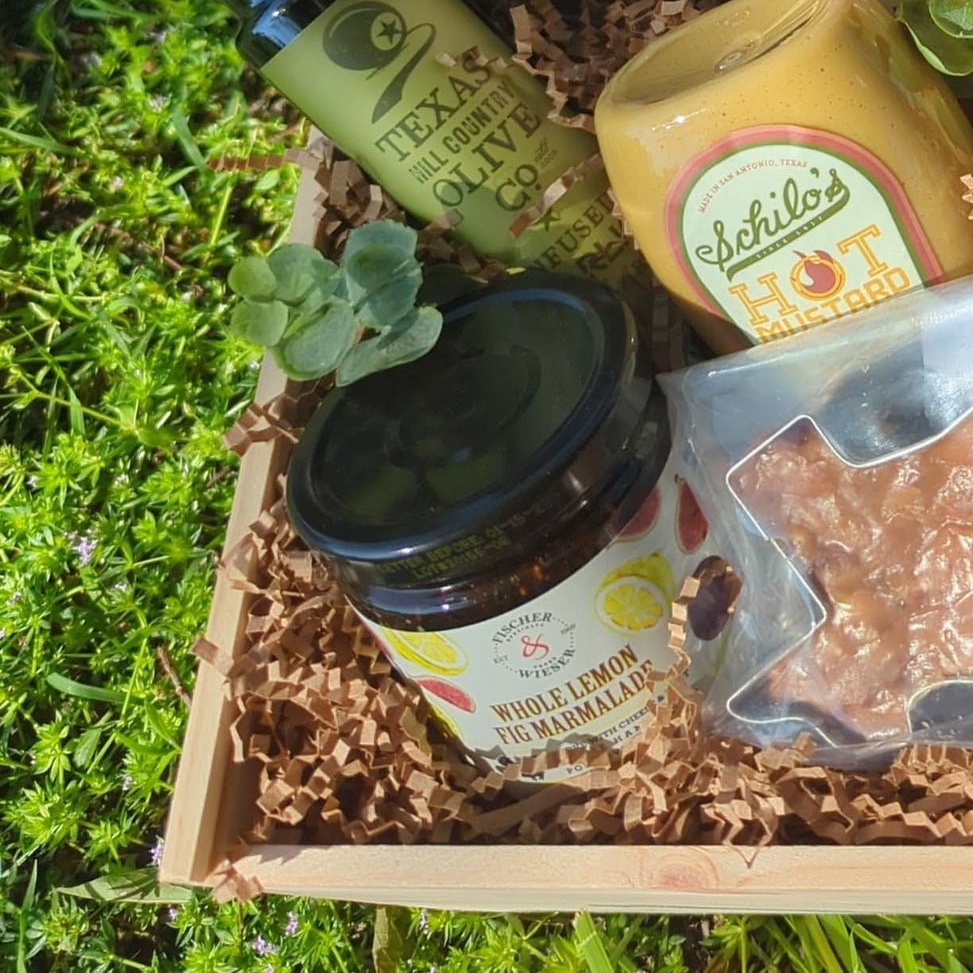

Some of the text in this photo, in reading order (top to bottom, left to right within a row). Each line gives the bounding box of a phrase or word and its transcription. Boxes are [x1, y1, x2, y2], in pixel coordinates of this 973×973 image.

[375, 53, 491, 162] TEXAS
[409, 80, 515, 184] HILL COUNTRY
[433, 101, 541, 207] OLIVE
[699, 192, 713, 214] MADE
[711, 183, 720, 194] IN
[720, 172, 734, 186] SAN
[780, 158, 808, 168] TEXAS
[695, 167, 844, 273] Schilo's
[727, 224, 889, 325] HOT
[753, 266, 911, 344] MUSTARD
[490, 643, 639, 723] WHOLE LEMON
[492, 612, 576, 679] FISCHER & WIESER
[494, 724, 532, 745] FIG
